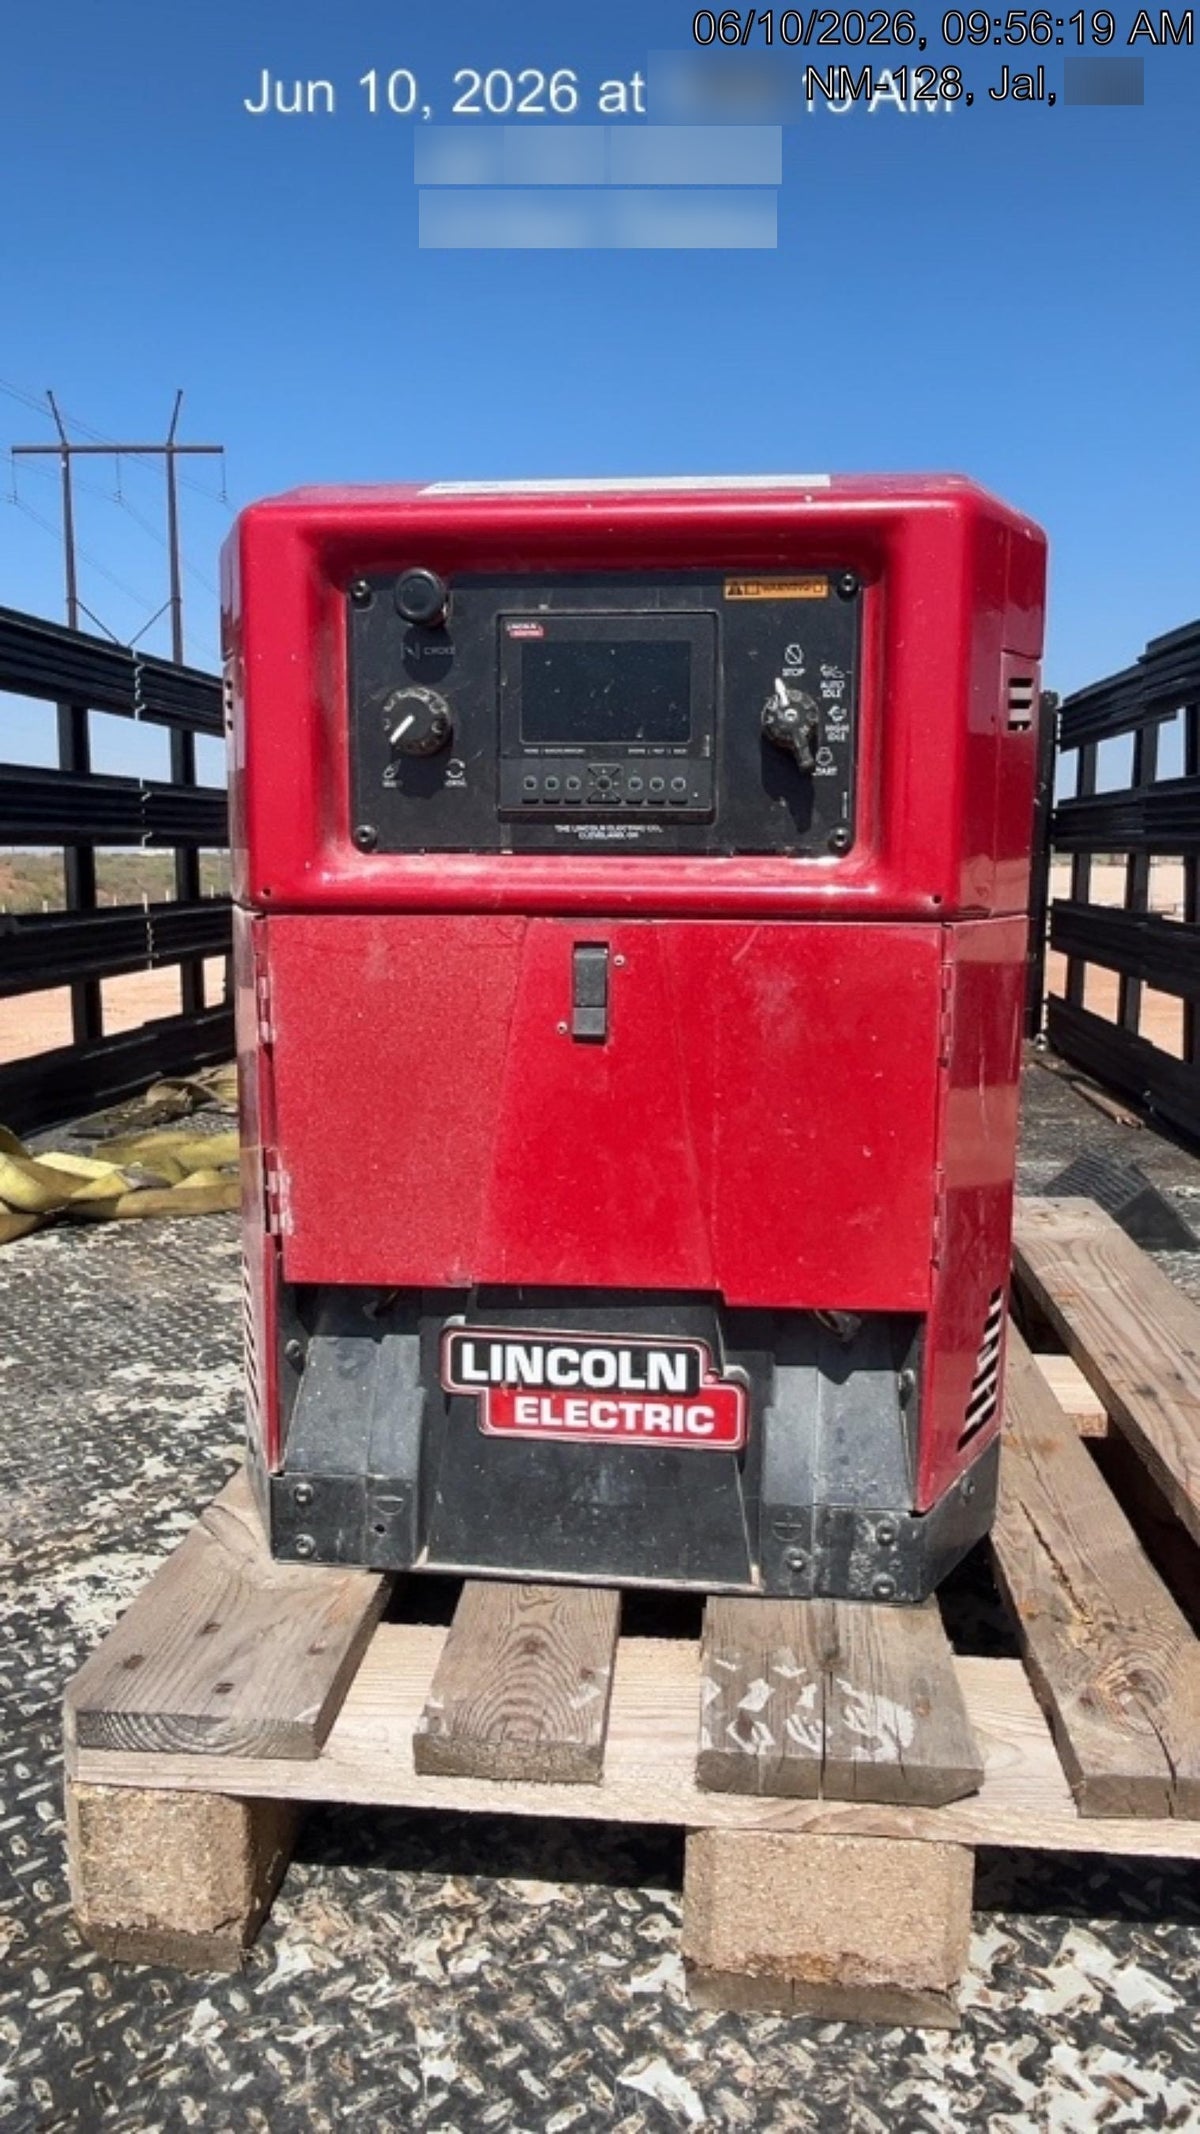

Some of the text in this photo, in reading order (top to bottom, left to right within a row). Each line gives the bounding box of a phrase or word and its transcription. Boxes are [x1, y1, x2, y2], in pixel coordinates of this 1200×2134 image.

[782, 668, 805, 677] STOP
[820, 681, 845, 690] AUTO
[822, 690, 842, 698] IDLE
[461, 1341, 687, 1391] LINCOLN
[513, 1395, 716, 1434] ELECTRIC
